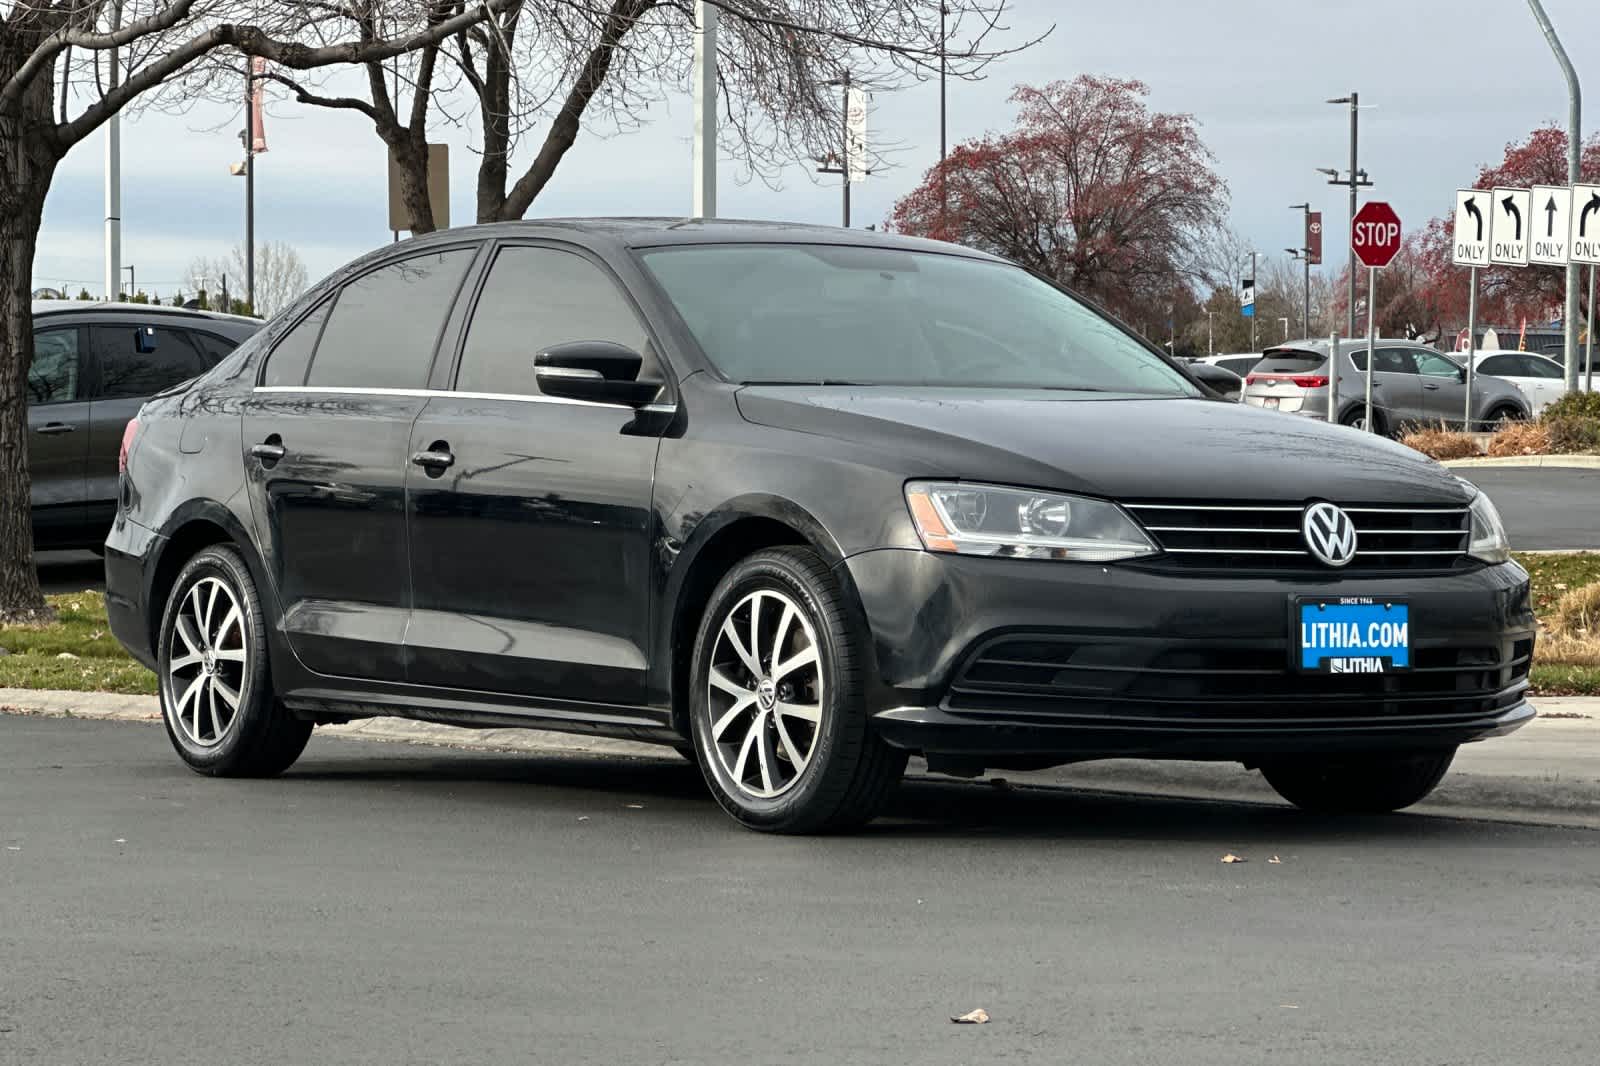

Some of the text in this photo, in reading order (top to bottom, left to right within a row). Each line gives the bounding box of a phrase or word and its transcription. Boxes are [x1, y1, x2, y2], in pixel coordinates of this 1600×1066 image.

[1355, 222, 1398, 246] STOP
[1457, 243, 1485, 260] ONLY
[1495, 242, 1524, 259] ONLY
[1535, 241, 1564, 258] ONLY
[1304, 503, 1357, 566] VW
[1340, 597, 1358, 605] SINCE
[1302, 622, 1408, 648] LITHIA.COM
[1343, 657, 1383, 673] LITHIA
